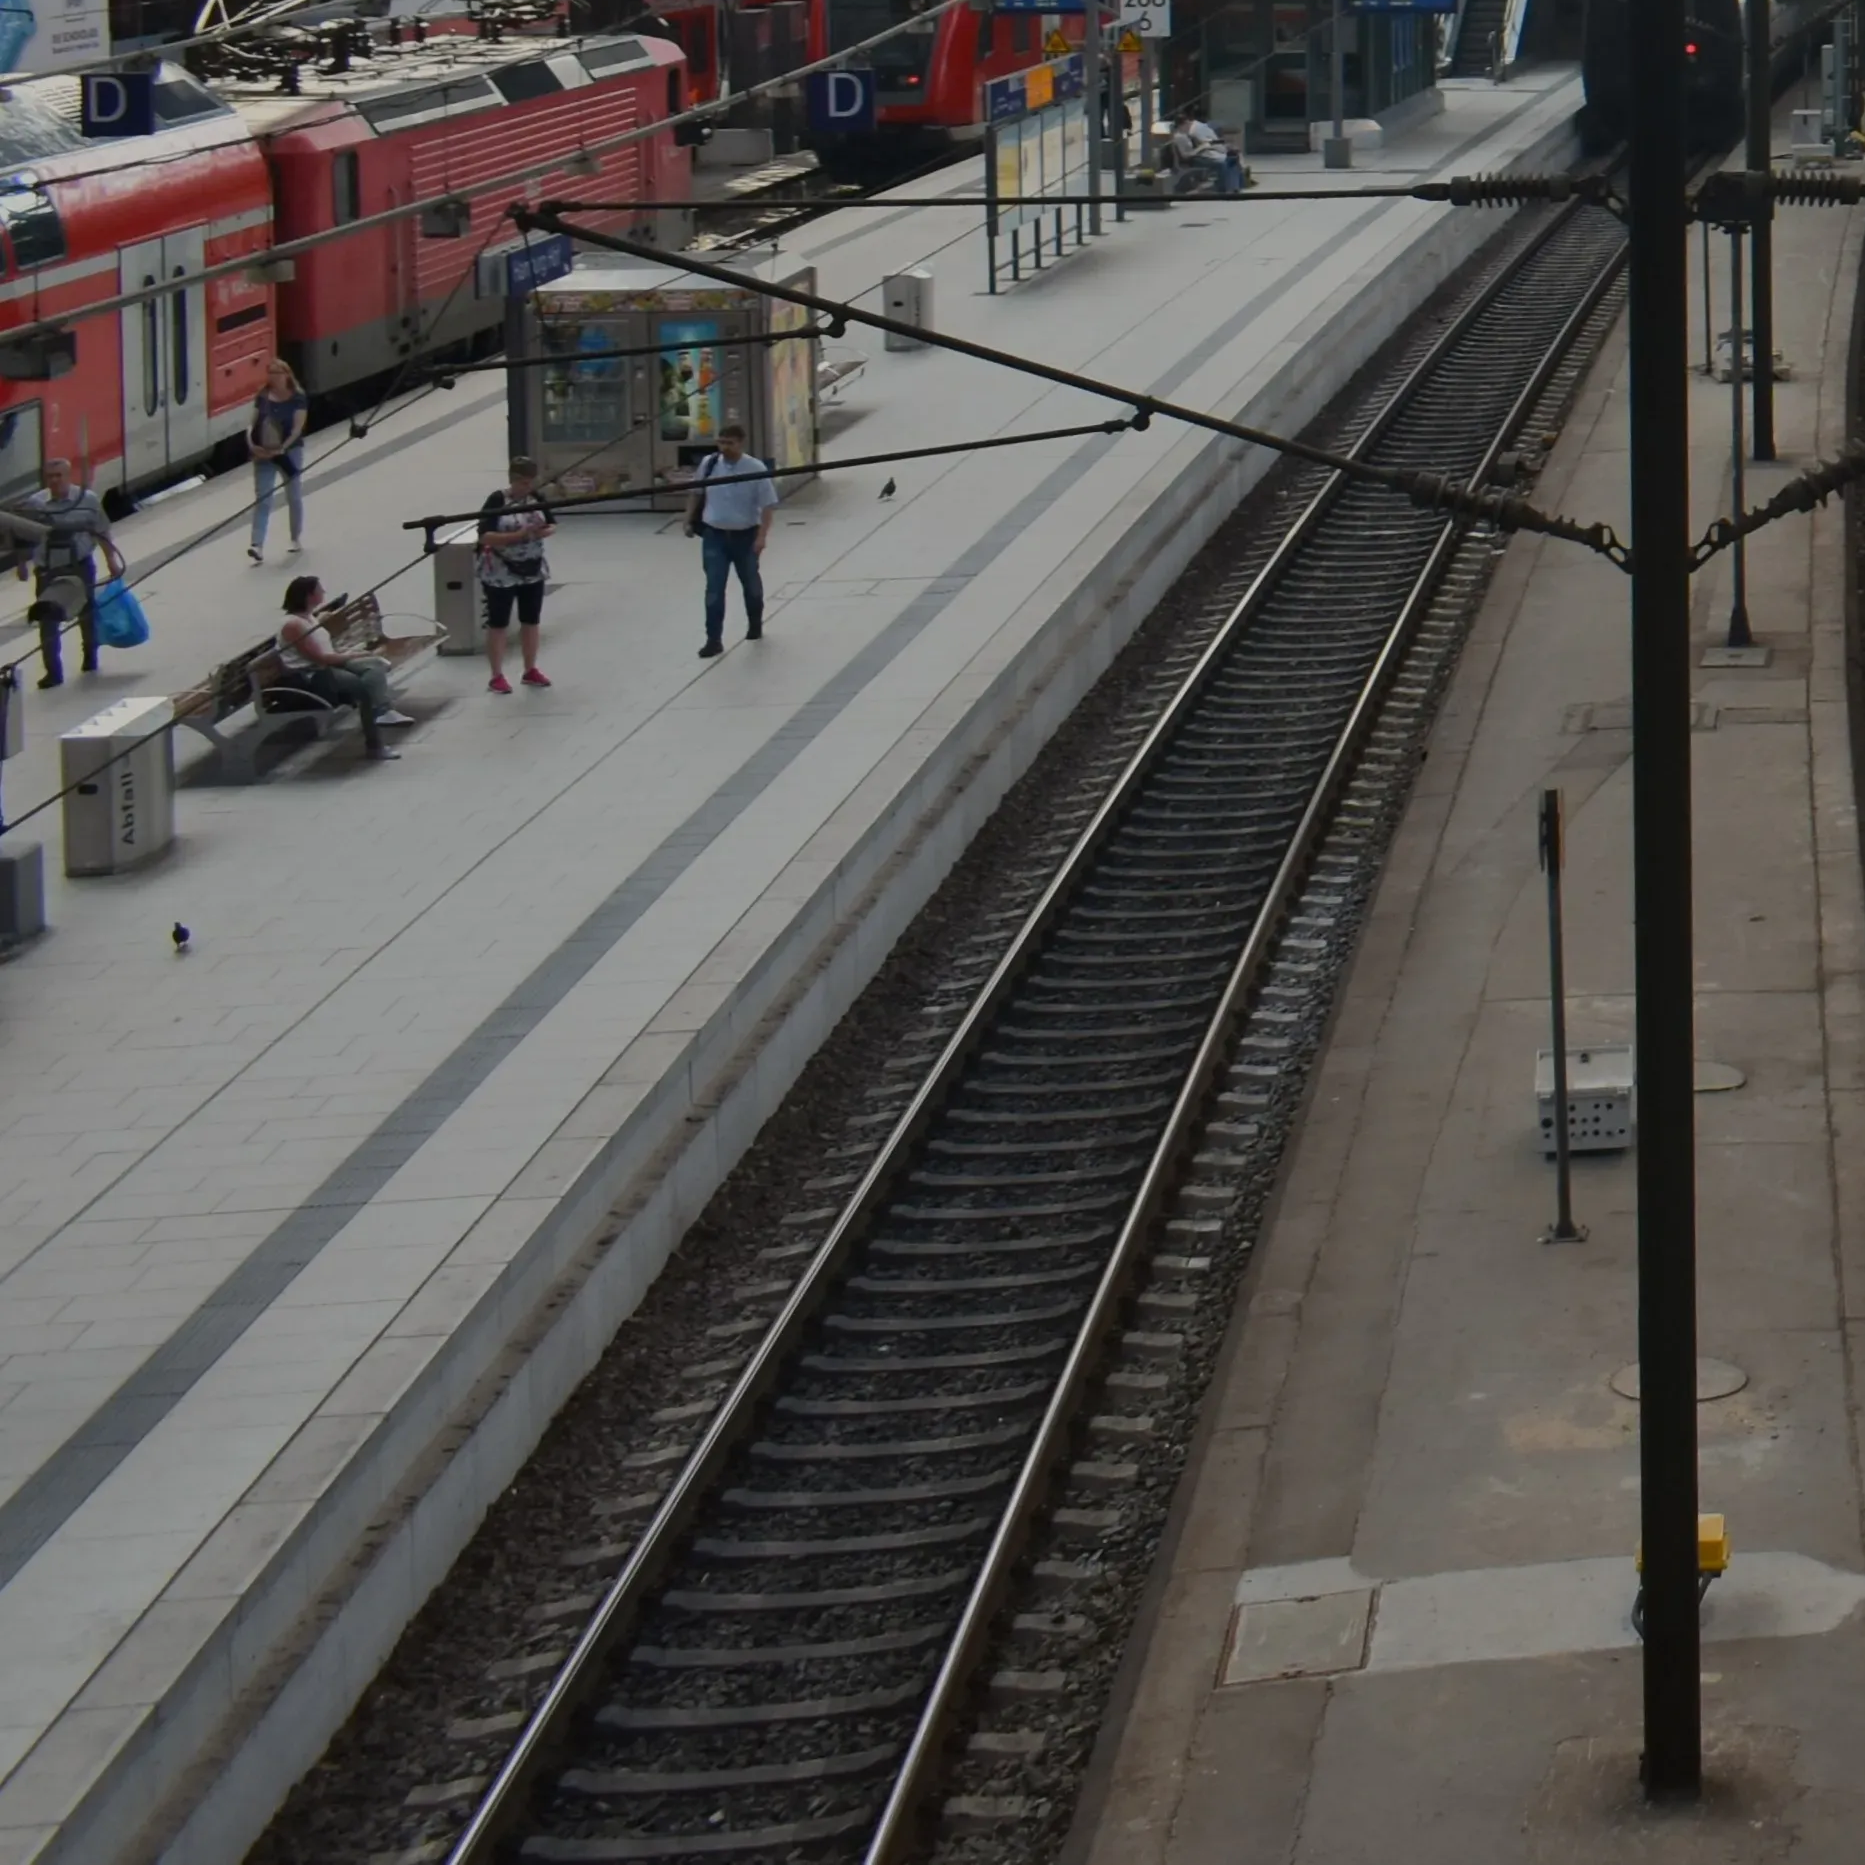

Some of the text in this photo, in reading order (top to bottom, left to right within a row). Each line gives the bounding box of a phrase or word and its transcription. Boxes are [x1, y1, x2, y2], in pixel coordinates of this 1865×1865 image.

[1138, 11, 1151, 31] 6
[88, 77, 128, 123] D
[827, 72, 864, 118] D
[120, 771, 136, 848] Abfall
